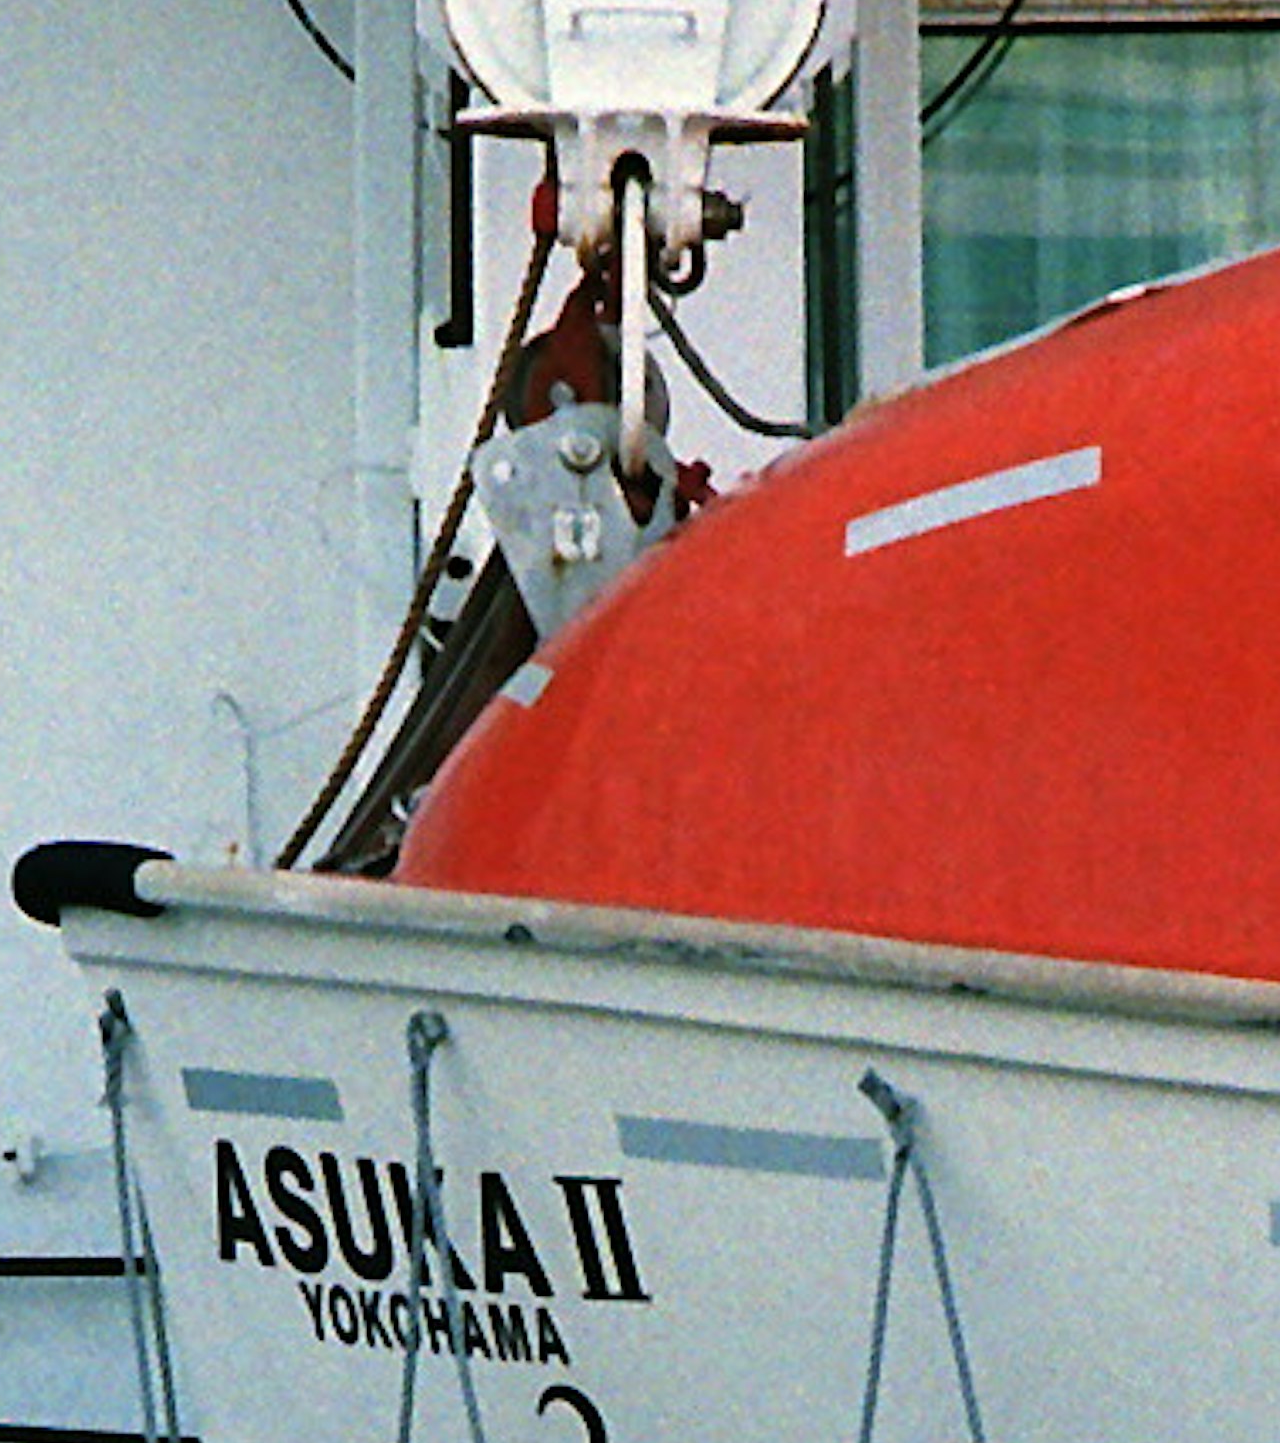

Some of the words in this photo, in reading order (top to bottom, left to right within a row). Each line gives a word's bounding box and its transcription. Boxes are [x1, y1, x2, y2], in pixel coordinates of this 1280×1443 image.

[216, 1138, 555, 1299] ASUKA
[552, 1175, 652, 1303] II
[298, 1280, 571, 1366] YOKOHAMA
